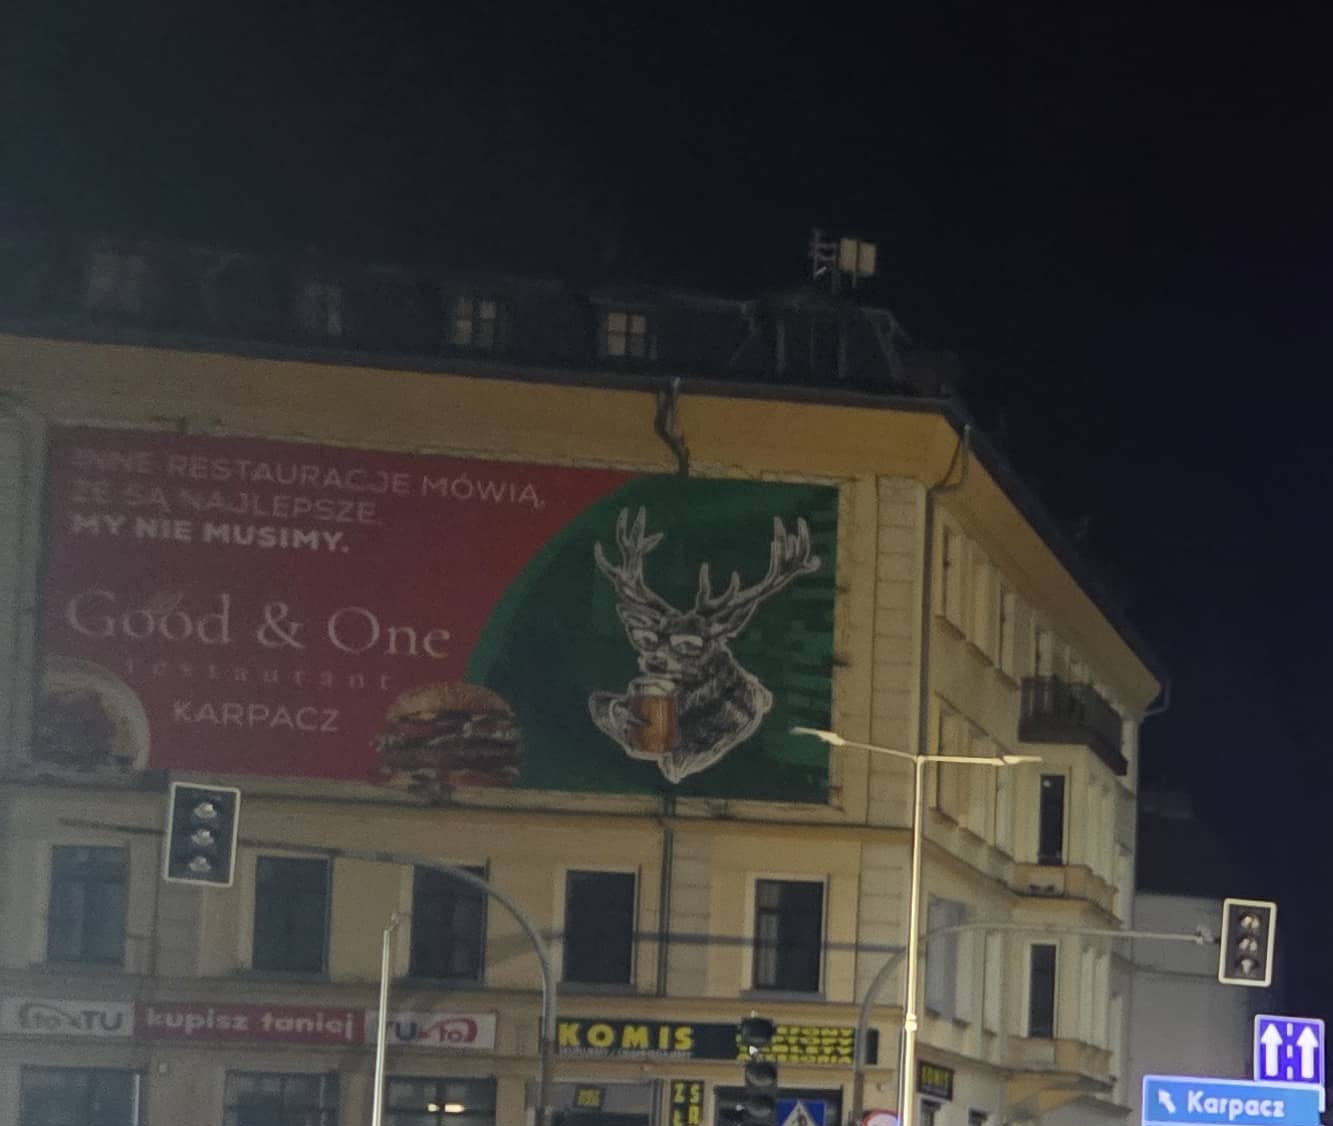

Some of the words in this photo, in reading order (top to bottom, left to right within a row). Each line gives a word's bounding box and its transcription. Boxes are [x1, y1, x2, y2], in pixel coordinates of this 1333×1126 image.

[168, 453, 411, 495] RESTAURACJE
[71, 513, 126, 537] MY
[134, 516, 193, 542] NIE
[202, 521, 350, 554] MUSIMY.
[69, 586, 231, 645] Good
[256, 601, 305, 650] &
[327, 606, 451, 660] One
[126, 660, 392, 692] restaurant
[172, 699, 340, 733] KARPACZ
[146, 1008, 250, 1035] kupisz
[261, 1011, 354, 1041] taniej
[558, 1021, 694, 1051] KOMIS
[1187, 1089, 1286, 1121] Karpacz
